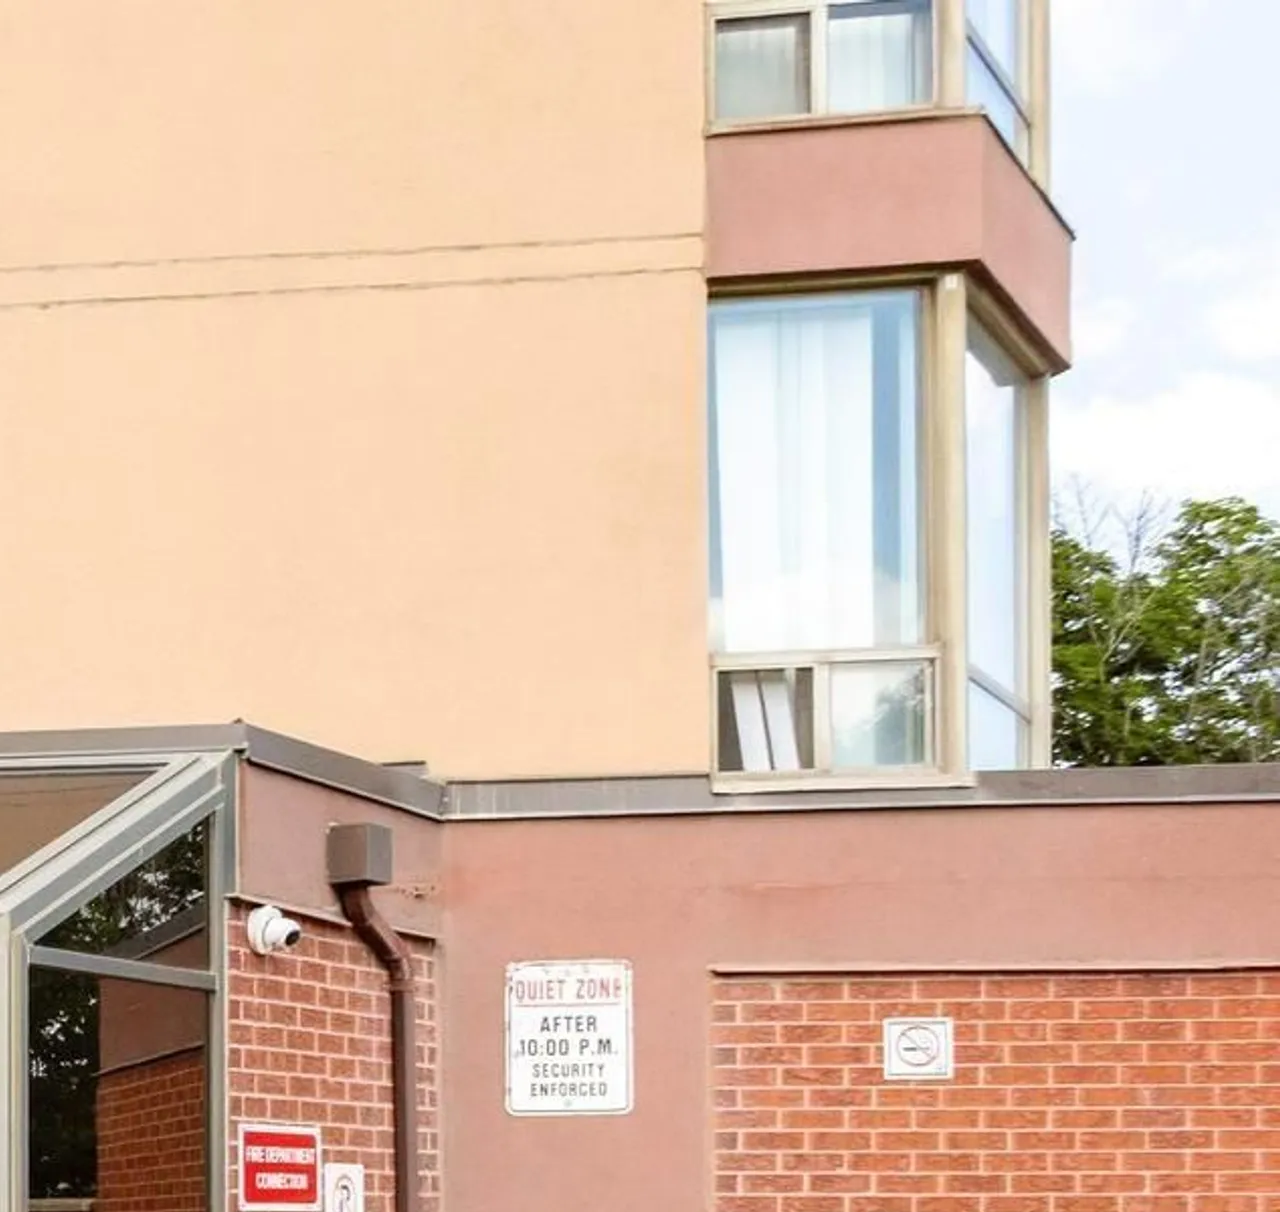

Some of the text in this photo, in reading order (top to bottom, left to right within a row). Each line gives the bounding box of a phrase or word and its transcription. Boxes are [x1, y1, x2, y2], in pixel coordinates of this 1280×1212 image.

[515, 978, 621, 1003] QUIET ZONE
[540, 1015, 598, 1033] AFTER
[519, 1038, 618, 1056] 10:00 P.M.
[532, 1063, 605, 1078] SECURITY
[530, 1082, 608, 1097] ENFORCED
